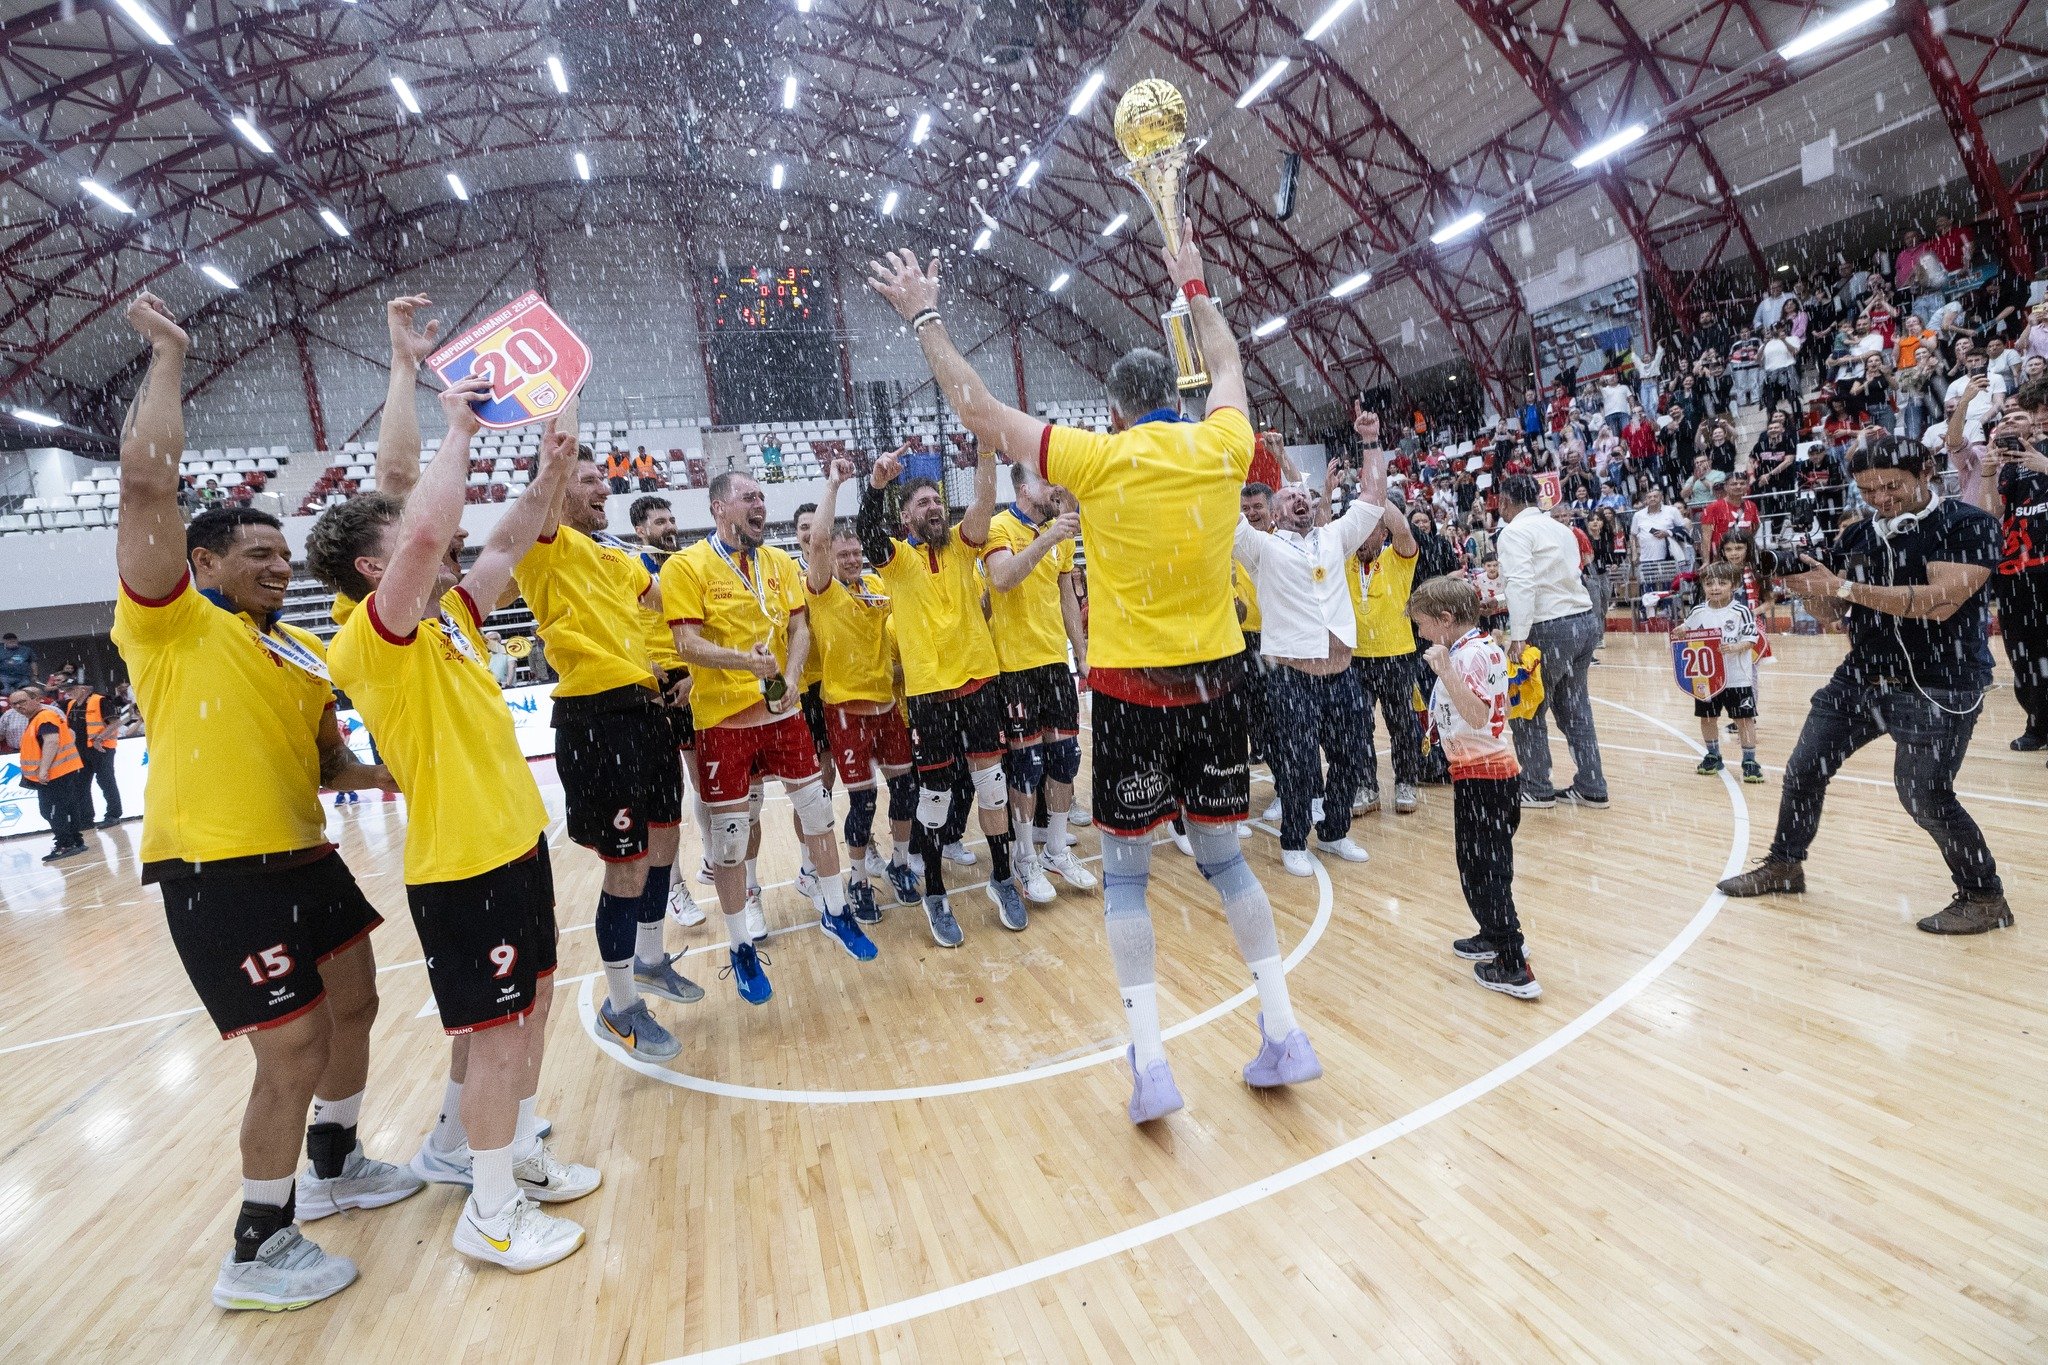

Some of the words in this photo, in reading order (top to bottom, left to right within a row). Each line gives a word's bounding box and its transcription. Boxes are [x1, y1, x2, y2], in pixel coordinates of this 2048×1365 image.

[430, 336, 475, 367] CAMPIONII
[472, 309, 513, 340] ROMÂNIEI
[511, 293, 538, 313] 25/26
[471, 329, 556, 403] 20
[713, 592, 733, 600] 2026
[1682, 646, 1715, 678] 20
[1006, 702, 1025, 719] 11
[844, 749, 856, 764] 2
[706, 761, 720, 779] 7
[613, 808, 632, 831] 6
[241, 943, 293, 985] 15
[490, 944, 516, 978] 9
[268, 991, 296, 1006] erima
[496, 991, 521, 1004] erima
[235, 1025, 259, 1037] DINAMO
[450, 1027, 474, 1035] DINAMO
